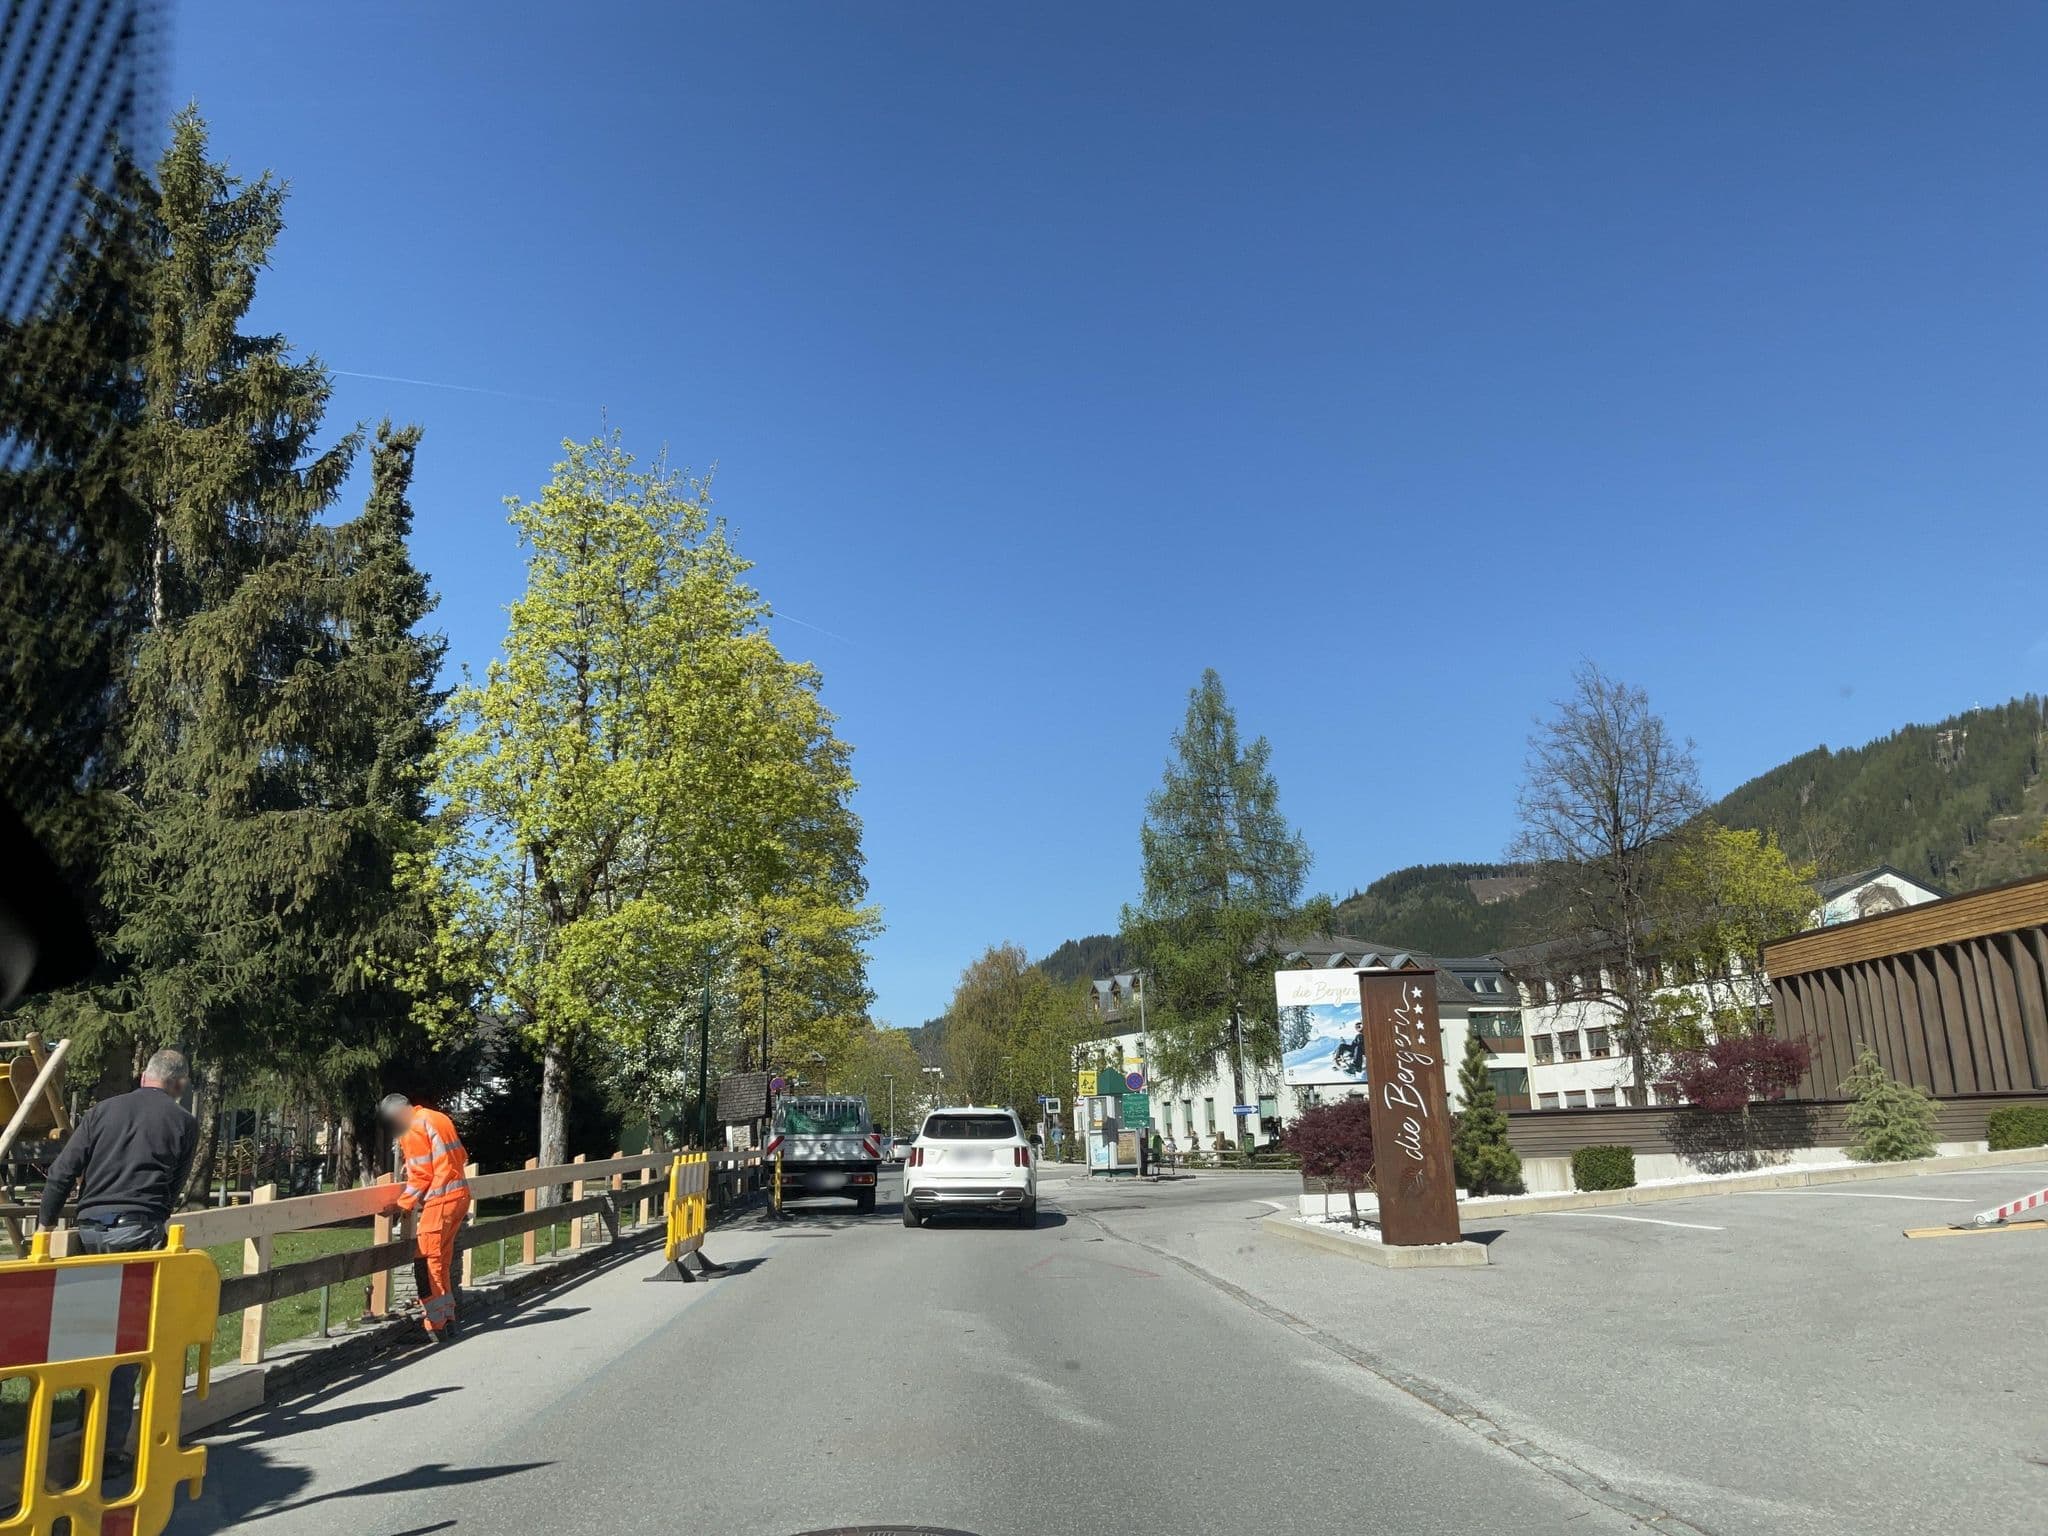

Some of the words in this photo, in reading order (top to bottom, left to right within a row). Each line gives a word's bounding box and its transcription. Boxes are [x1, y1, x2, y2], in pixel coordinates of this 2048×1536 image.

[1292, 984, 1311, 999] die
[1384, 981, 1433, 1117] Bergerin
[1394, 1116, 1423, 1160] die
